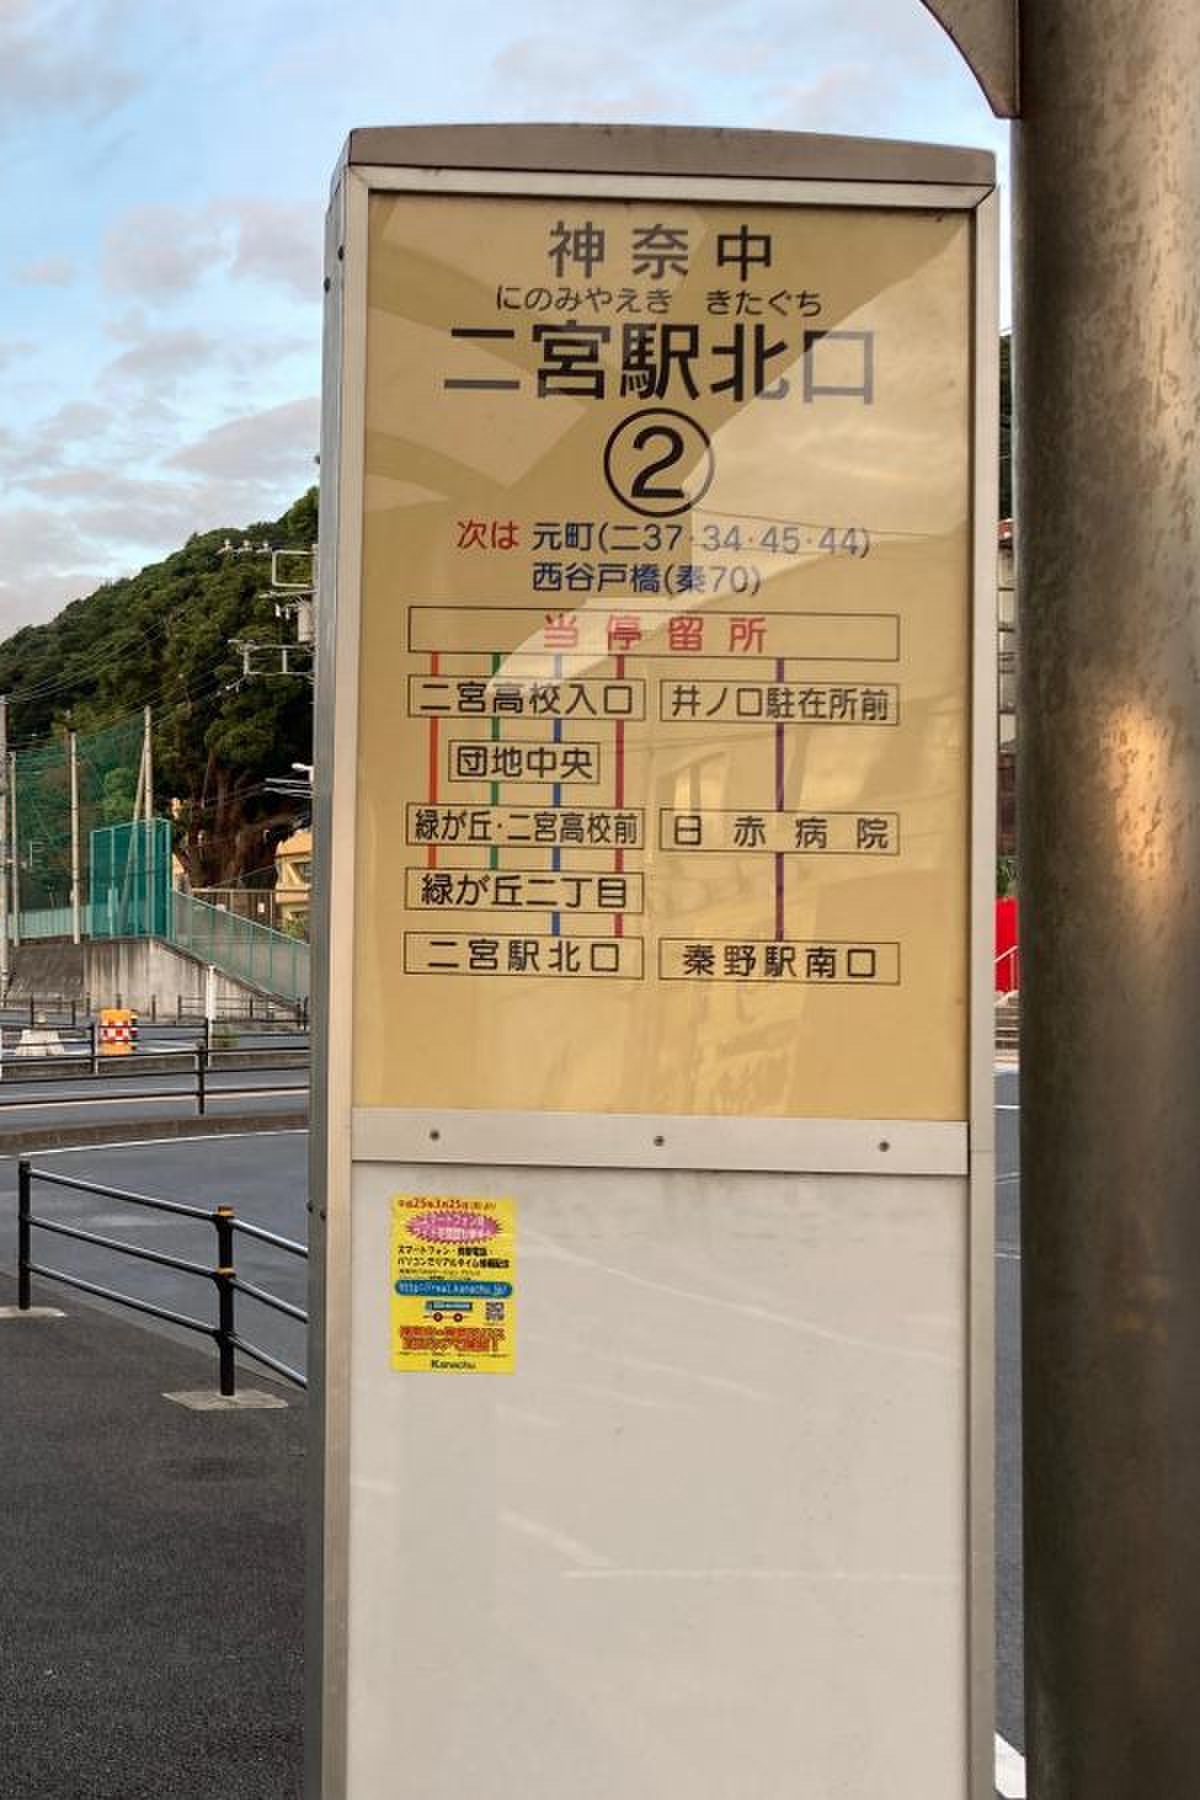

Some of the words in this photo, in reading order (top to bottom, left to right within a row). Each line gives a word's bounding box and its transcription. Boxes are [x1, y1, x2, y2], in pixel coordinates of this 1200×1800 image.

[548, 220, 772, 282] 神奈中
[496, 284, 673, 315] にのみやえき
[706, 289, 823, 317] きたぐち
[444, 320, 875, 405] 二宮駅北口
[456, 519, 520, 551] 次は
[543, 612, 770, 655] 当停留所
[420, 680, 633, 717] 二宮高校入口
[671, 684, 890, 721] 井ノ口駐在所前
[455, 745, 594, 781] 団地中央
[673, 814, 890, 851] 日赤病院
[421, 876, 628, 911] 緑が丘二丁目
[426, 938, 620, 973] 二宮駅北口
[682, 945, 878, 979] 秦野駅南口
